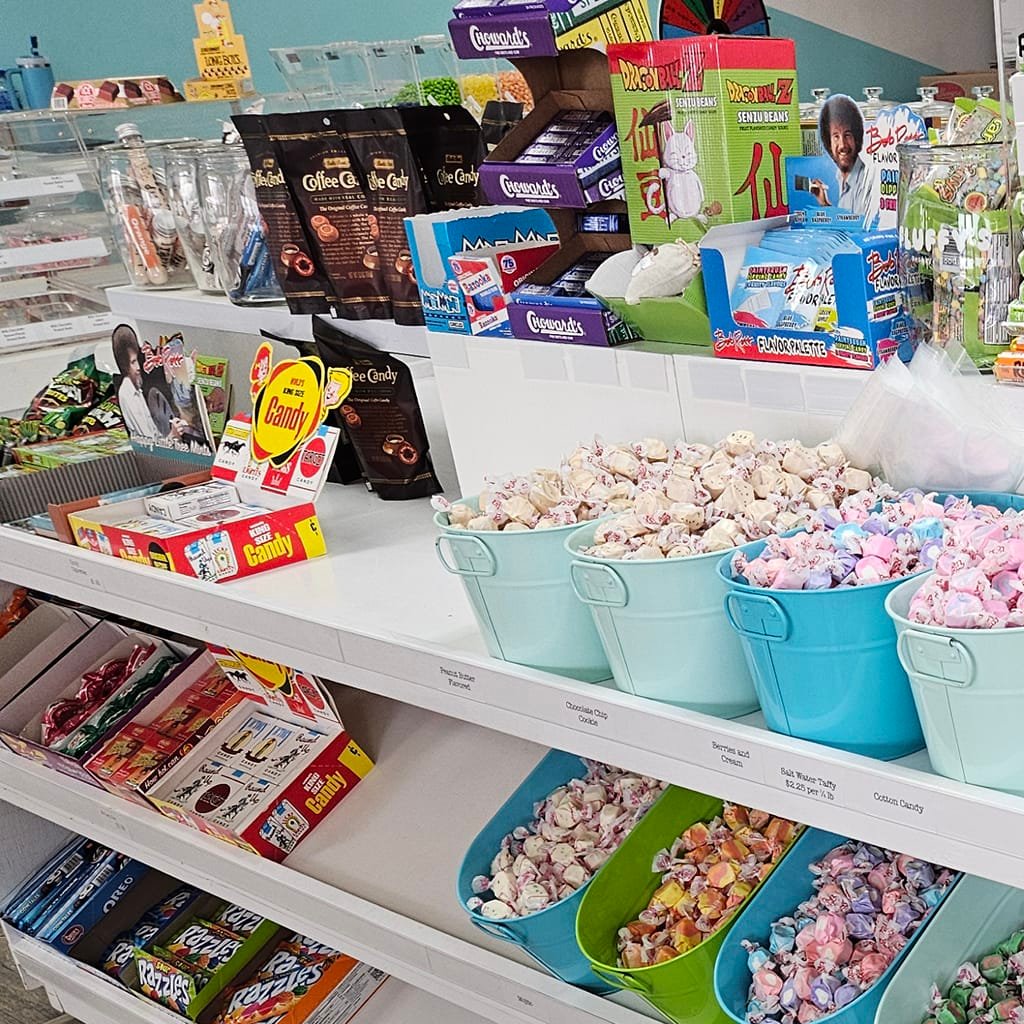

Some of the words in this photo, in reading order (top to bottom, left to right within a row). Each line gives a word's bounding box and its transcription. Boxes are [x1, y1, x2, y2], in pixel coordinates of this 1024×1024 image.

[777, 78, 794, 104] Z
[675, 97, 696, 108] SENZU
[697, 96, 718, 107] BEANS
[737, 111, 763, 123] SENZU
[764, 110, 789, 123] BEANS
[866, 125, 894, 154] Bob
[873, 153, 898, 163] FLAVOR
[302, 171, 339, 191] Coffee
[455, 165, 479, 187] Candy
[503, 258, 515, 268] 75
[875, 274, 900, 291] FLAVOR
[757, 335, 790, 354] FLAVOR
[789, 337, 827, 358] PALETTE
[367, 365, 398, 384] Candy
[264, 395, 309, 440] Candy
[296, 477, 313, 485] CANDY
[248, 524, 271, 538] KING
[254, 532, 273, 545] SIZE
[243, 532, 294, 567] Candy
[565, 701, 593, 717] Chocolate
[578, 714, 599, 727] Cookie
[711, 741, 736, 755] Berries
[737, 747, 750, 759] and
[720, 755, 744, 768] Cream
[311, 779, 326, 795] SIZE
[780, 767, 794, 778] Salt
[795, 771, 817, 785] Water
[818, 777, 837, 791] Taffy
[305, 770, 348, 815] Candy
[785, 779, 806, 793] $2.25
[806, 786, 819, 797] per
[826, 791, 834, 800] lb
[873, 791, 899, 807] Cotton
[900, 798, 924, 815] Candy
[103, 875, 135, 914] OREO
[173, 925, 243, 963] Razzles
[138, 959, 190, 1005] Razzles
[228, 963, 324, 1015] Razzles
